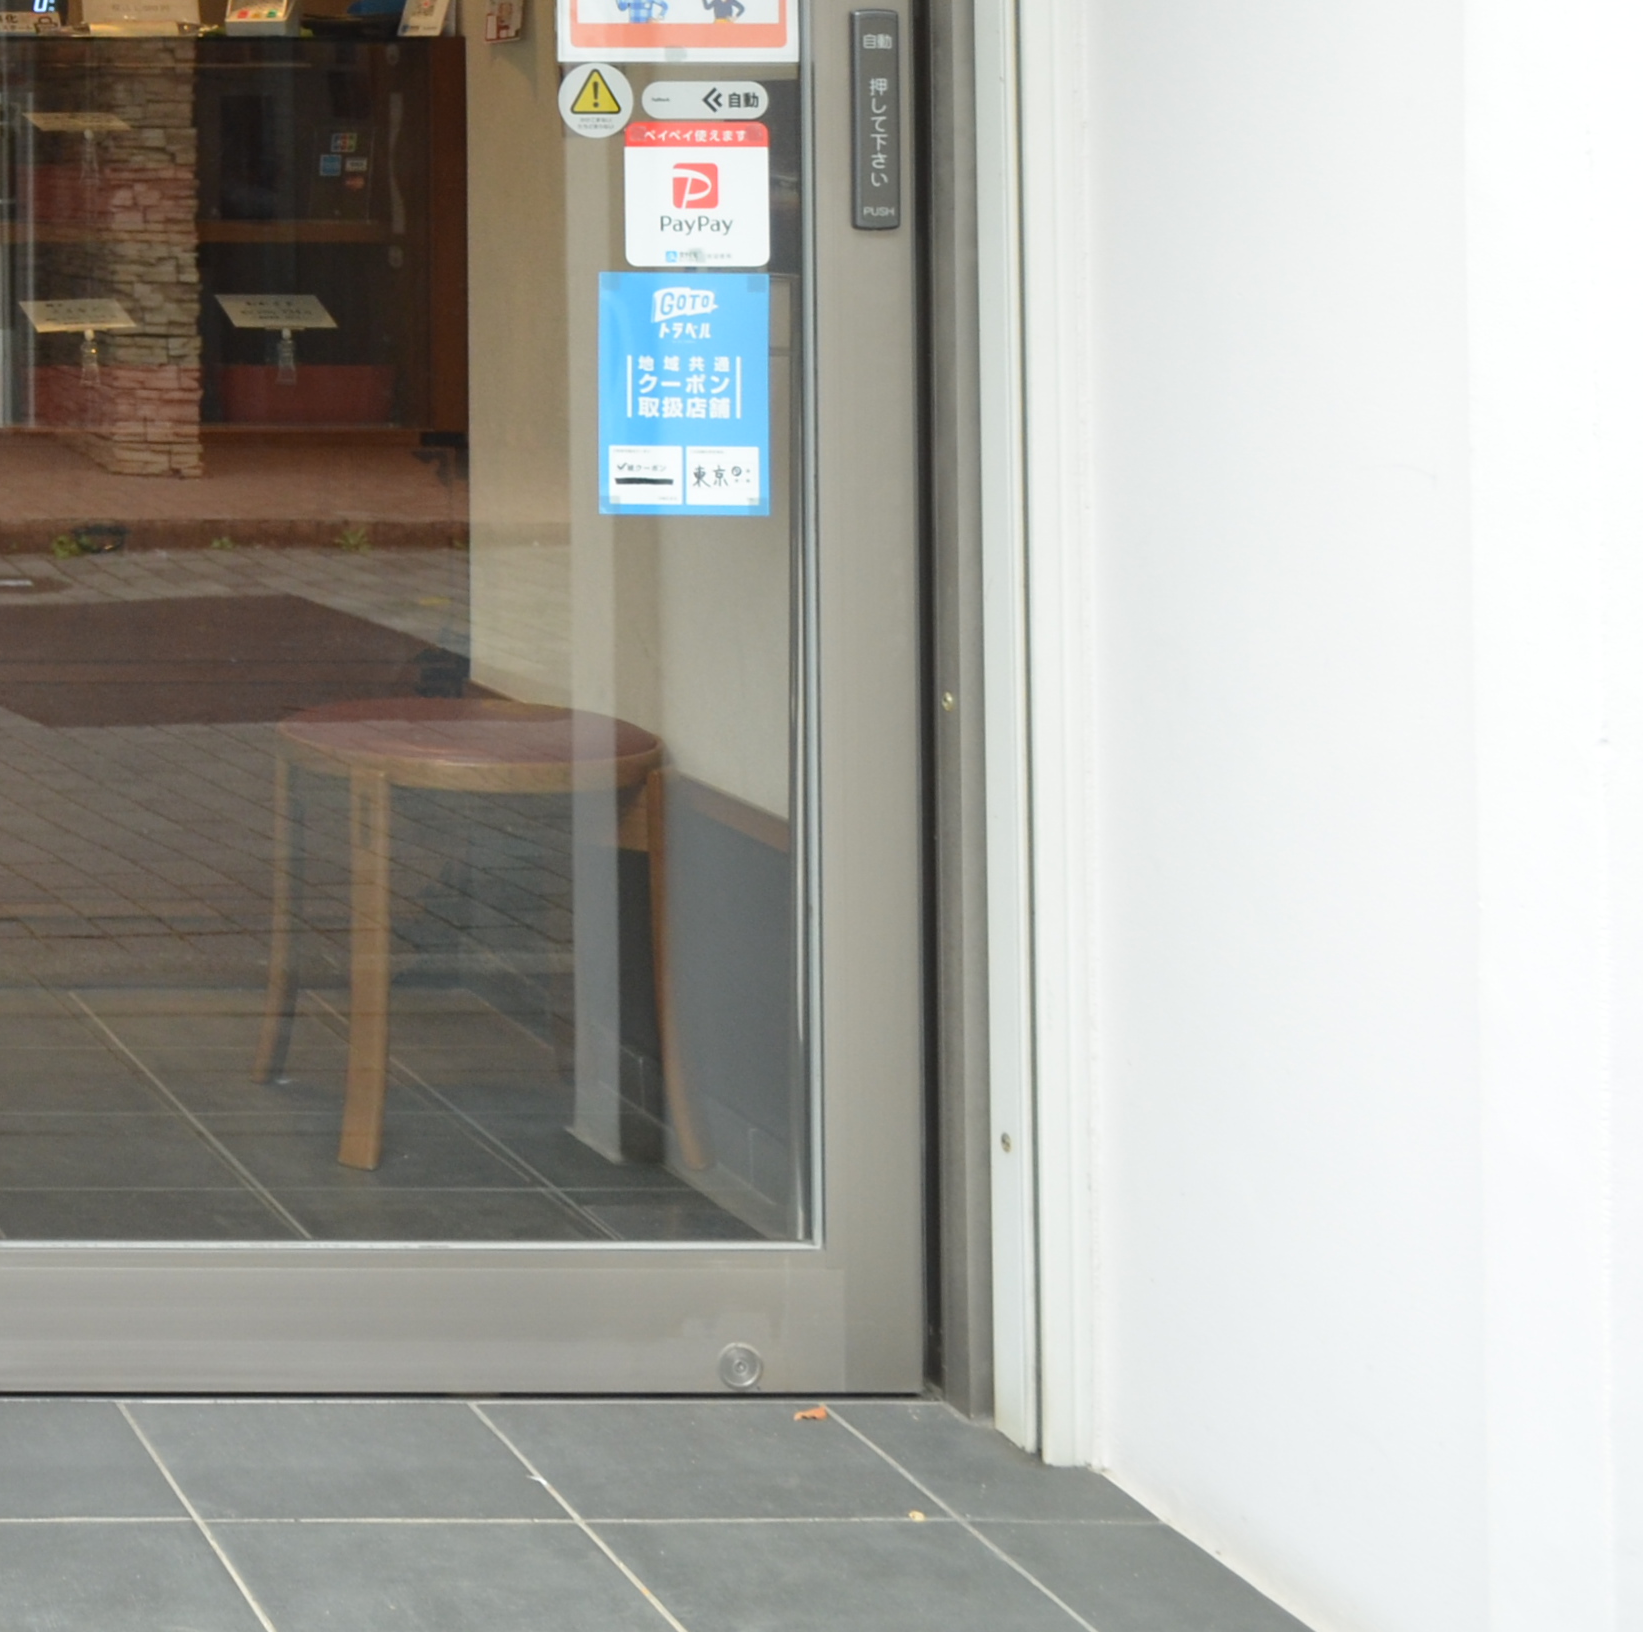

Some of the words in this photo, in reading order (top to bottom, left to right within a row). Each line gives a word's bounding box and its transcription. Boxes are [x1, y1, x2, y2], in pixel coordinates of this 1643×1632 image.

[863, 33, 893, 50] 自動
[728, 92, 760, 109] 自動
[644, 129, 747, 143] ペイペイ使えます
[869, 77, 889, 188] 押して下さい
[863, 207, 895, 217] PUSH
[660, 215, 734, 236] PayPay
[659, 322, 712, 340] トラベル
[638, 355, 731, 373] 地域共通
[638, 373, 731, 395] クーポン
[638, 396, 731, 420] 取扱店舗
[692, 464, 729, 488] 東京
